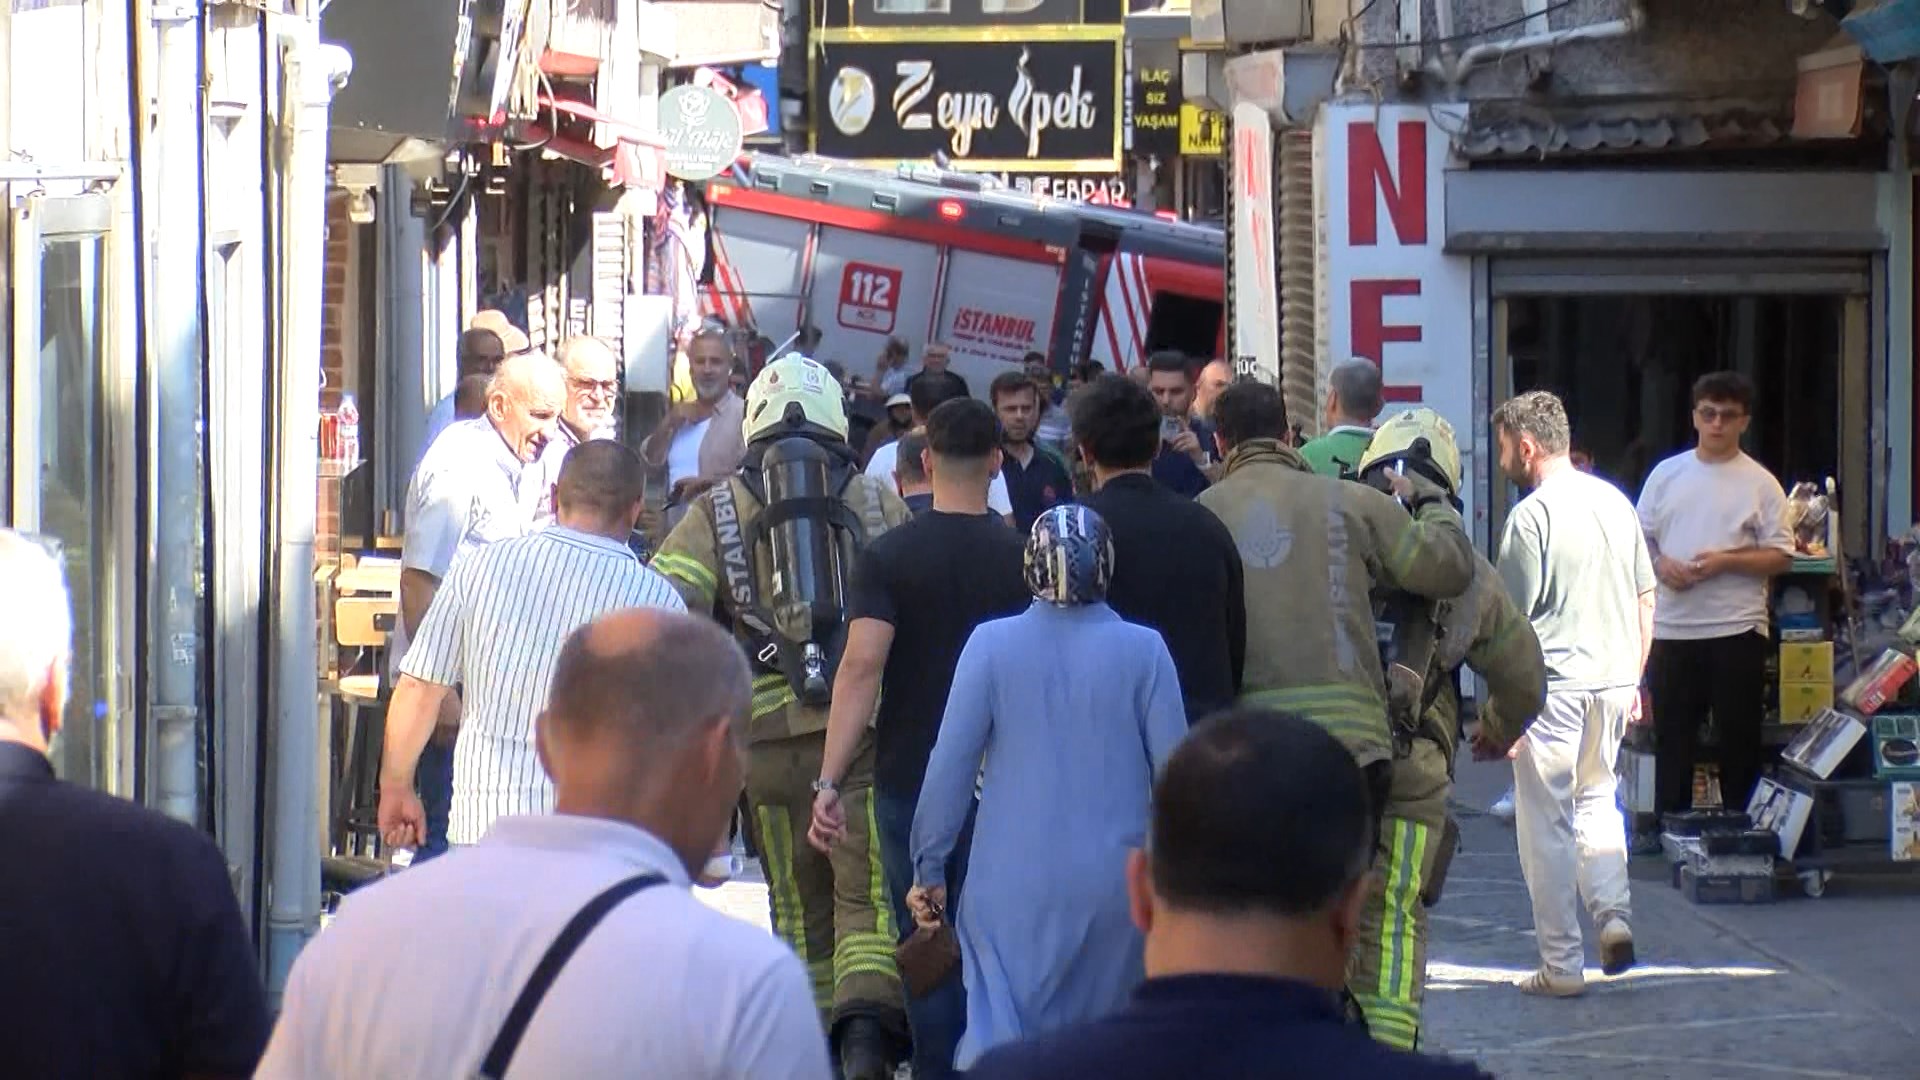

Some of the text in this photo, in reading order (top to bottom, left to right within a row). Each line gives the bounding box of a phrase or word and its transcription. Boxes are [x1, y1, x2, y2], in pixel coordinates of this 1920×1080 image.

[893, 61, 999, 157] Zeyn
[1135, 114, 1178, 130] YAŞAM
[850, 270, 892, 307] 112
